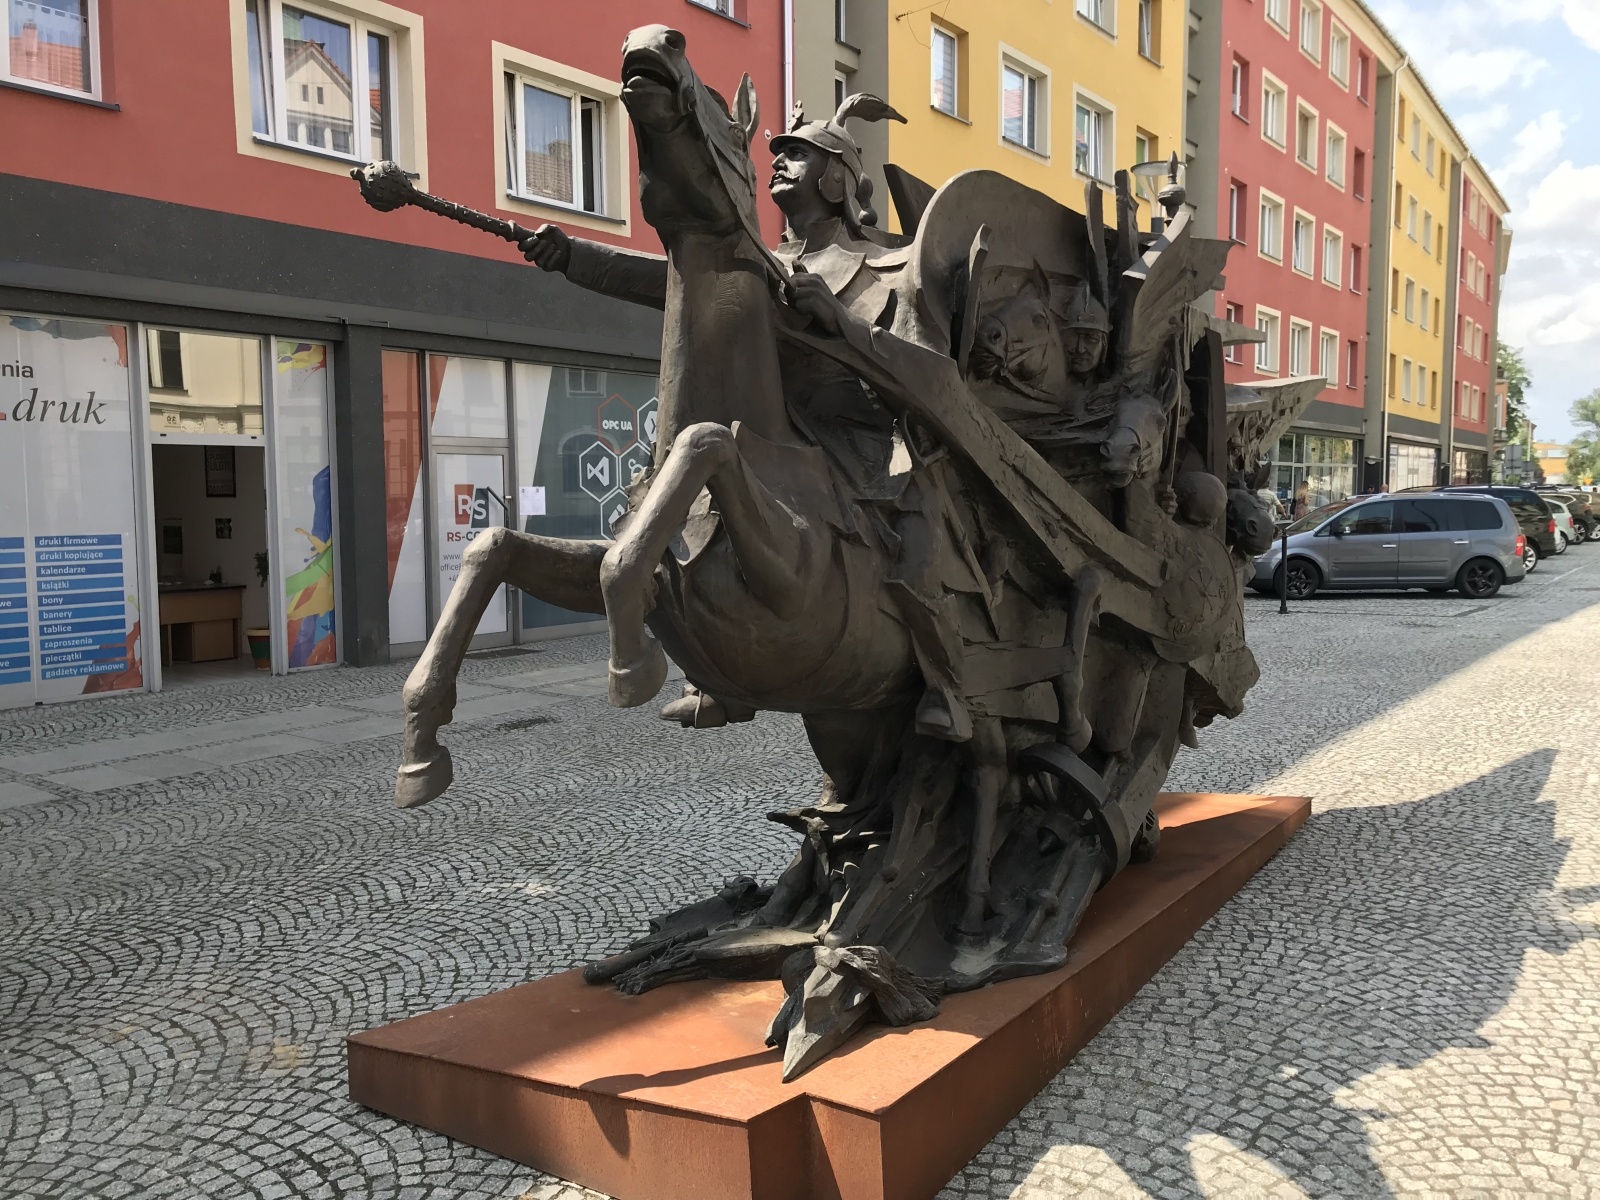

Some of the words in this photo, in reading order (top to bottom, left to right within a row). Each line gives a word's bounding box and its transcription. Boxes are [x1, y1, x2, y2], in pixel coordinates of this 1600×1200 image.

[0, 360, 34, 378] nia
[12, 388, 107, 424] druk
[602, 419, 619, 430] OPC
[621, 421, 633, 431] UA
[457, 494, 487, 520] RS
[39, 537, 61, 546] druki
[63, 536, 99, 545] firmowe
[40, 552, 62, 560] druki
[64, 550, 104, 560] kopiujące
[40, 566, 86, 575] kalendarze
[41, 580, 70, 590] książki
[42, 596, 64, 605] bony
[43, 610, 72, 619] banery
[43, 625, 72, 633] tablice
[44, 637, 93, 649] zaproszenia
[45, 652, 82, 664] pieczątki
[45, 667, 78, 679] gadżety
[80, 662, 125, 674] reklamowe
